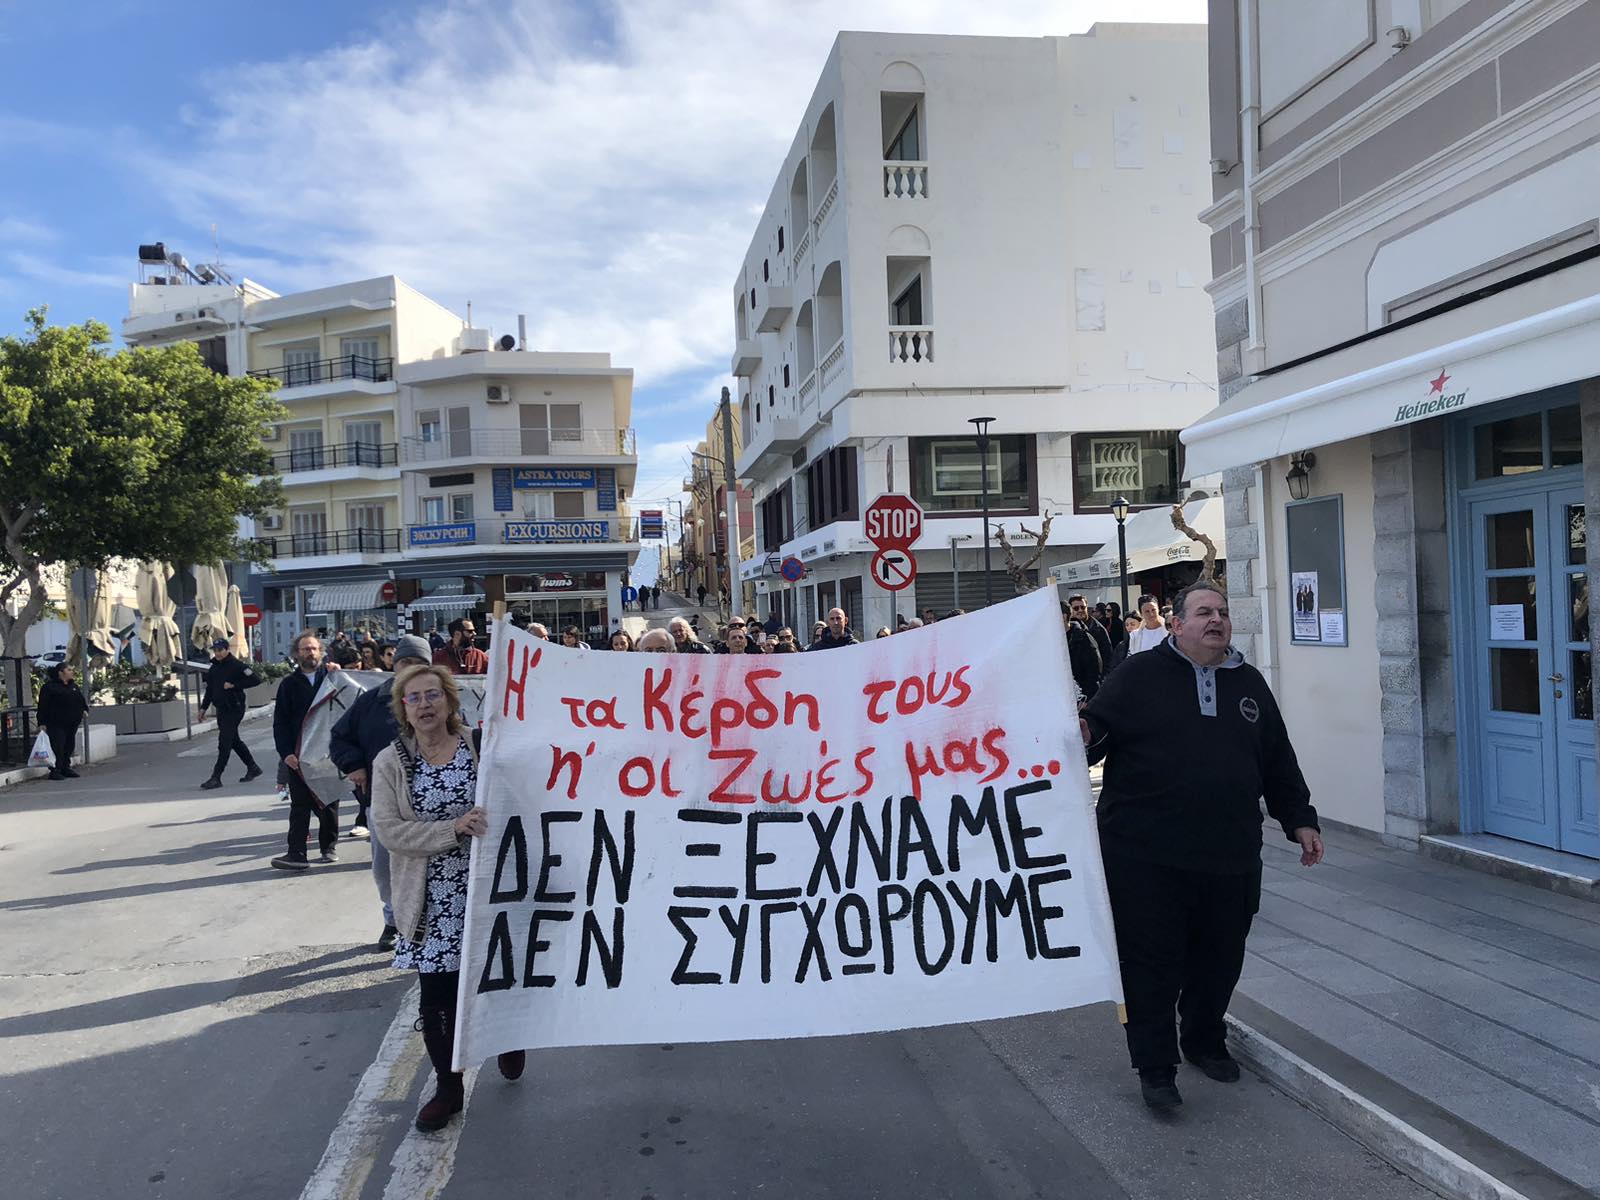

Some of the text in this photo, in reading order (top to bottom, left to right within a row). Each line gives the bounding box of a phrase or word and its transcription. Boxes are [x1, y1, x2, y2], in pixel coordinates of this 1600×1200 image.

[1394, 392, 1466, 422] Heineken
[516, 470, 592, 480] ASTRA TOURS
[412, 528, 468, 541] ЭКСКУРСИИ
[507, 523, 602, 539] EXCURSIONS
[868, 508, 918, 538] STOP
[560, 695, 627, 730] τα
[643, 668, 820, 749] Κέρδη
[862, 665, 972, 724] τους
[618, 756, 682, 798] οι
[708, 739, 876, 804] Ζωές
[489, 779, 1067, 906] ΔΕΝ ΞΕΧΝΑΜΕ
[476, 868, 1081, 995] ΔΕΝ ΣΥΓΧΩΡΟΥΜΕ
